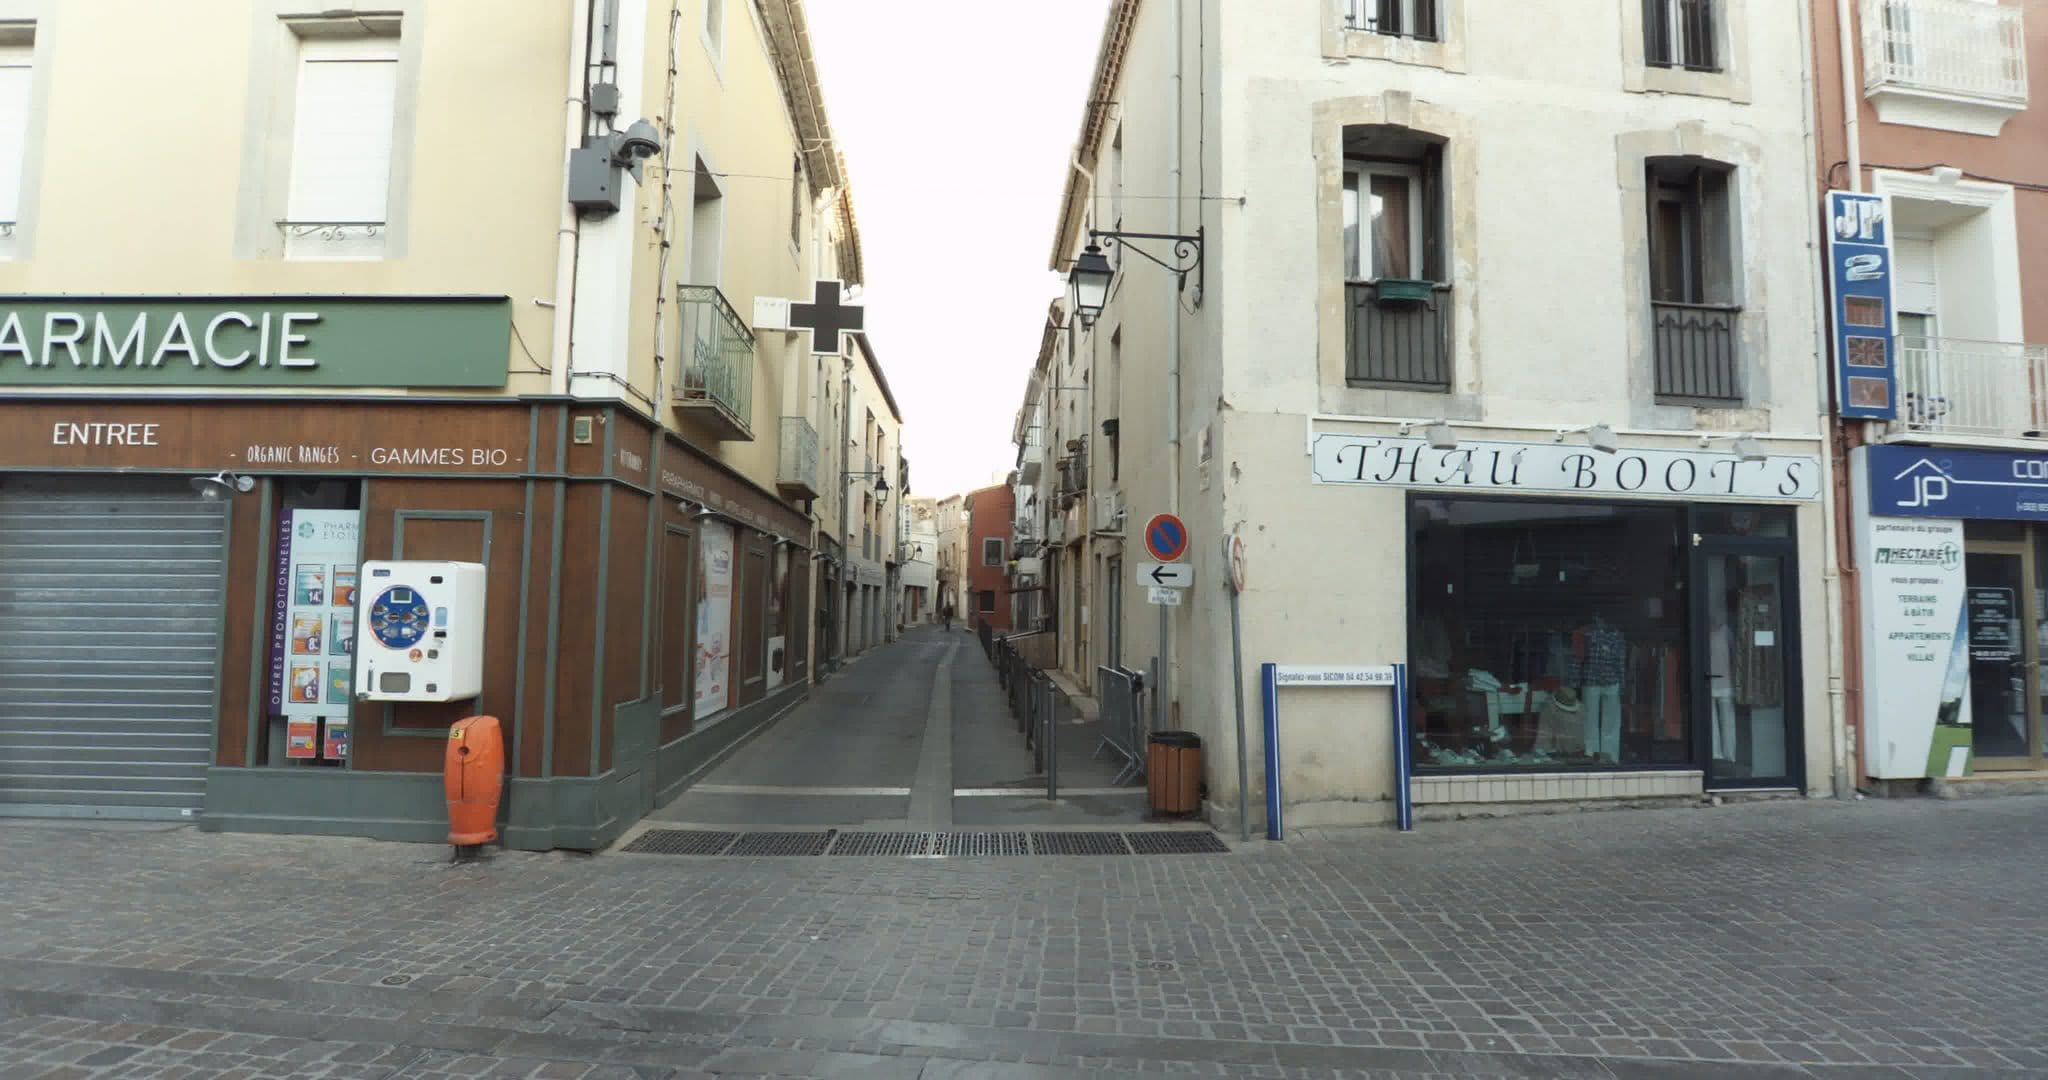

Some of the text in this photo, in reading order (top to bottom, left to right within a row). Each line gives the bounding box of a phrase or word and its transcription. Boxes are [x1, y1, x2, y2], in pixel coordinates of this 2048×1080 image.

[1844, 254, 1885, 282] 2
[53, 422, 160, 446] ENTREE
[247, 444, 508, 467] ORGANIC RANGES GAMMES BIO
[1336, 439, 1528, 486] THAU
[1896, 475, 1948, 508] JP
[271, 519, 290, 705] OFFRES PROMOTIONNELLES
